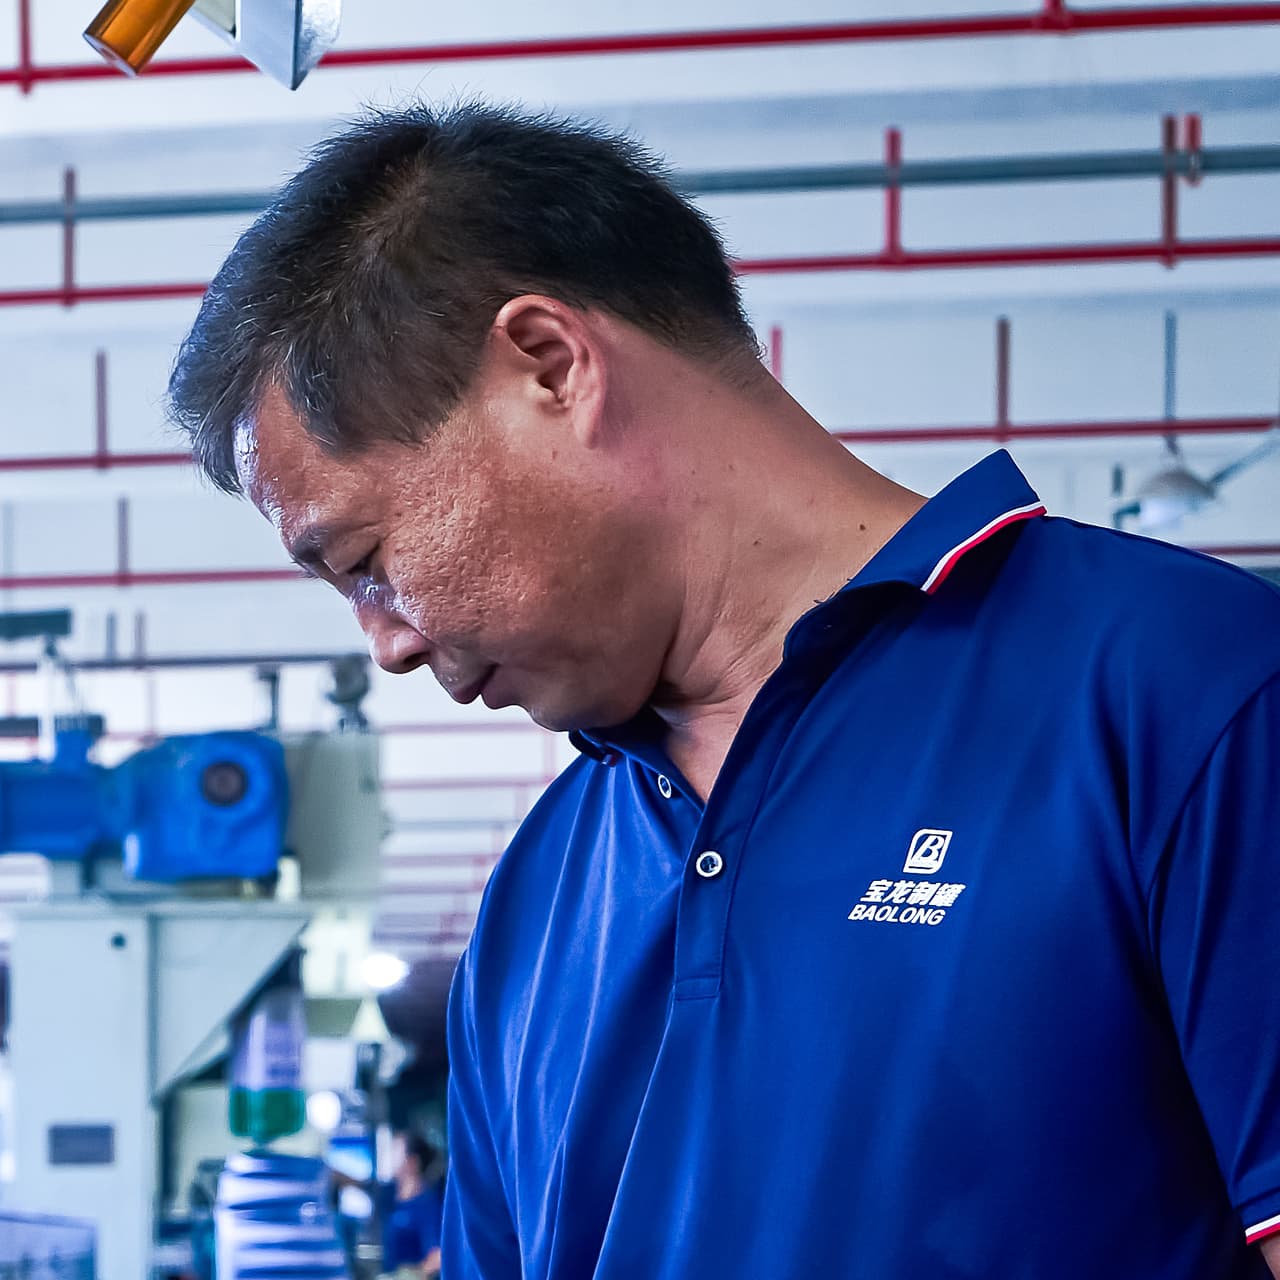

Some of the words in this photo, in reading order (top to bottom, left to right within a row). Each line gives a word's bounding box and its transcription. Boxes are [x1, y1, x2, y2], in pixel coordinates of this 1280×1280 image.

[860, 879, 966, 907] 宝龙制罐
[848, 904, 946, 925] BAOLONG
